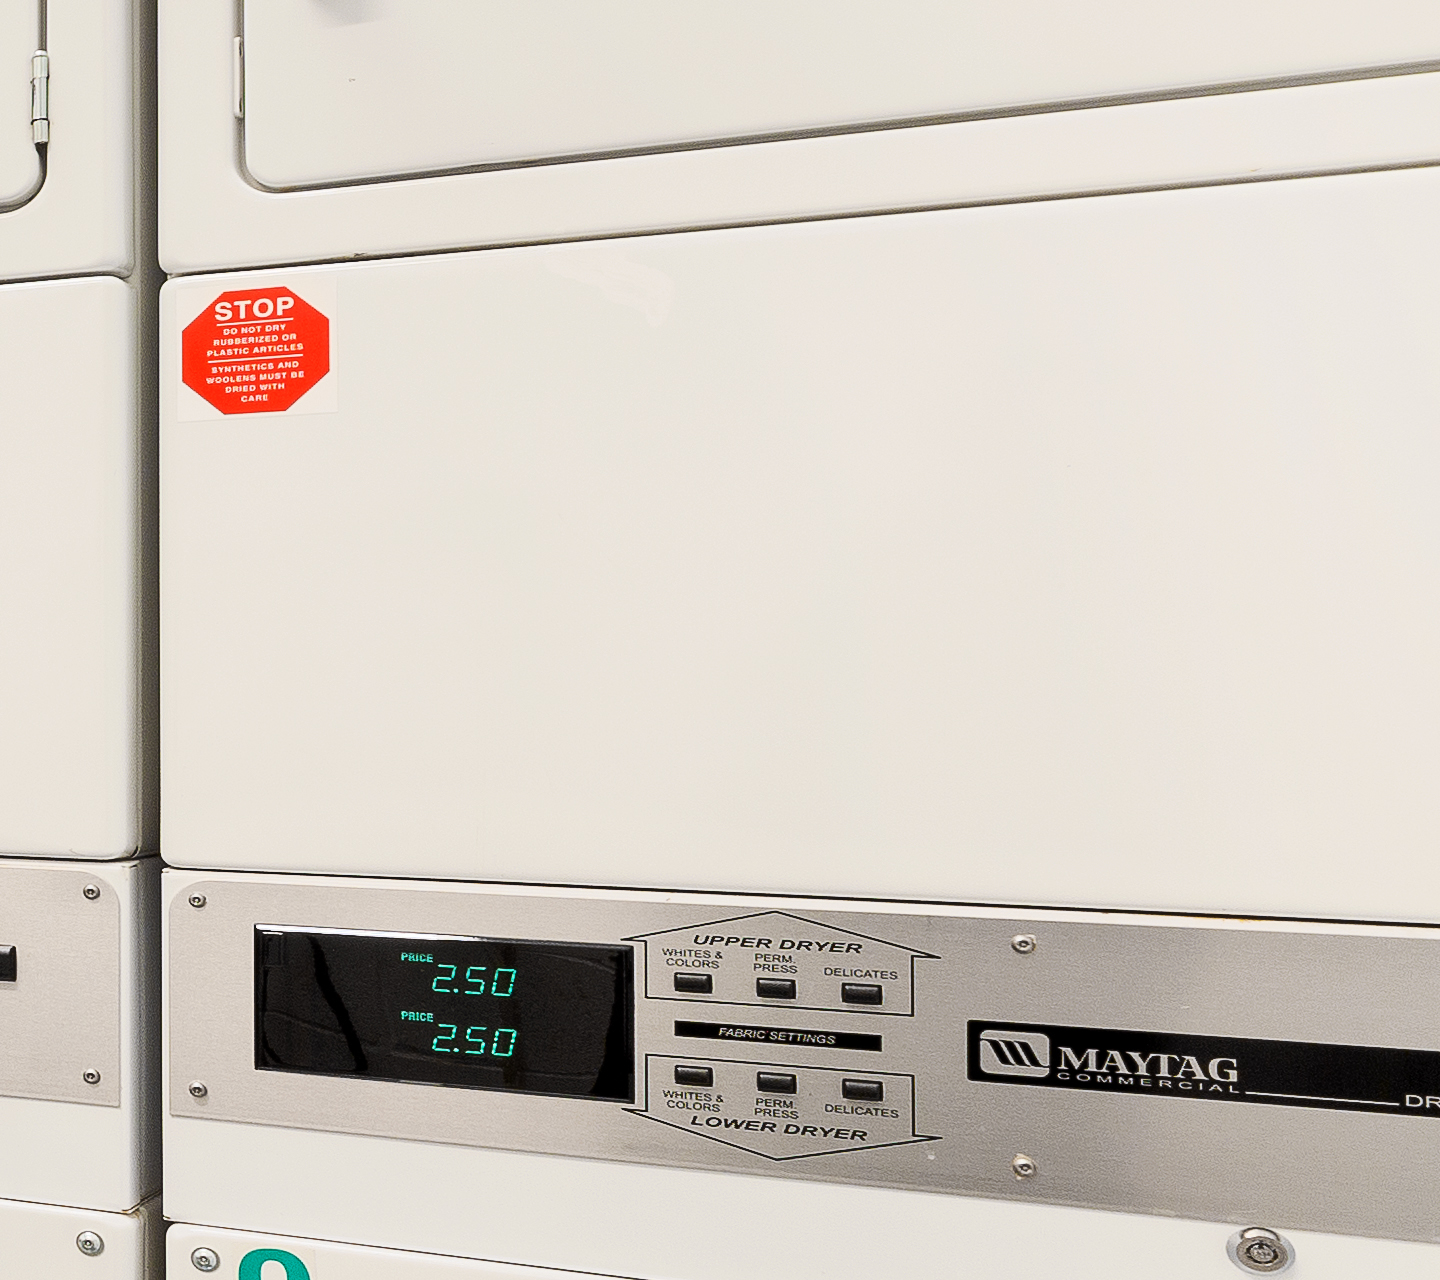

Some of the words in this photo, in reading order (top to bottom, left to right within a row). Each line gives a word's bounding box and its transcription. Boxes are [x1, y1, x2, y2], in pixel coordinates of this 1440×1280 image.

[215, 296, 294, 320] STOP
[241, 325, 262, 334] NOT
[265, 324, 286, 332] DRY
[213, 334, 278, 346] RUBBERIZED
[282, 333, 297, 341] OR
[207, 348, 250, 357] PLASTIC
[253, 343, 303, 353] ARTICLES
[211, 362, 274, 373] SYNTHETICS
[278, 361, 299, 369] AND
[206, 374, 256, 384] WOOLENS
[259, 372, 287, 381] MUST
[225, 385, 256, 393] DRIED
[260, 383, 285, 391] WITH
[241, 394, 268, 402] CARE
[692, 933, 774, 950] UPPER
[778, 937, 863, 954] DRYER
[400, 951, 434, 964] PRICE
[432, 964, 517, 998] 2.50
[400, 1010, 434, 1023] PRICE
[432, 1023, 517, 1058] 2.50
[1056, 1047, 1238, 1083] MAYTAG
[1056, 1072, 1241, 1094] COMMERCIAL
[689, 1114, 777, 1135] LOWER
[783, 1122, 869, 1142] DRYER
